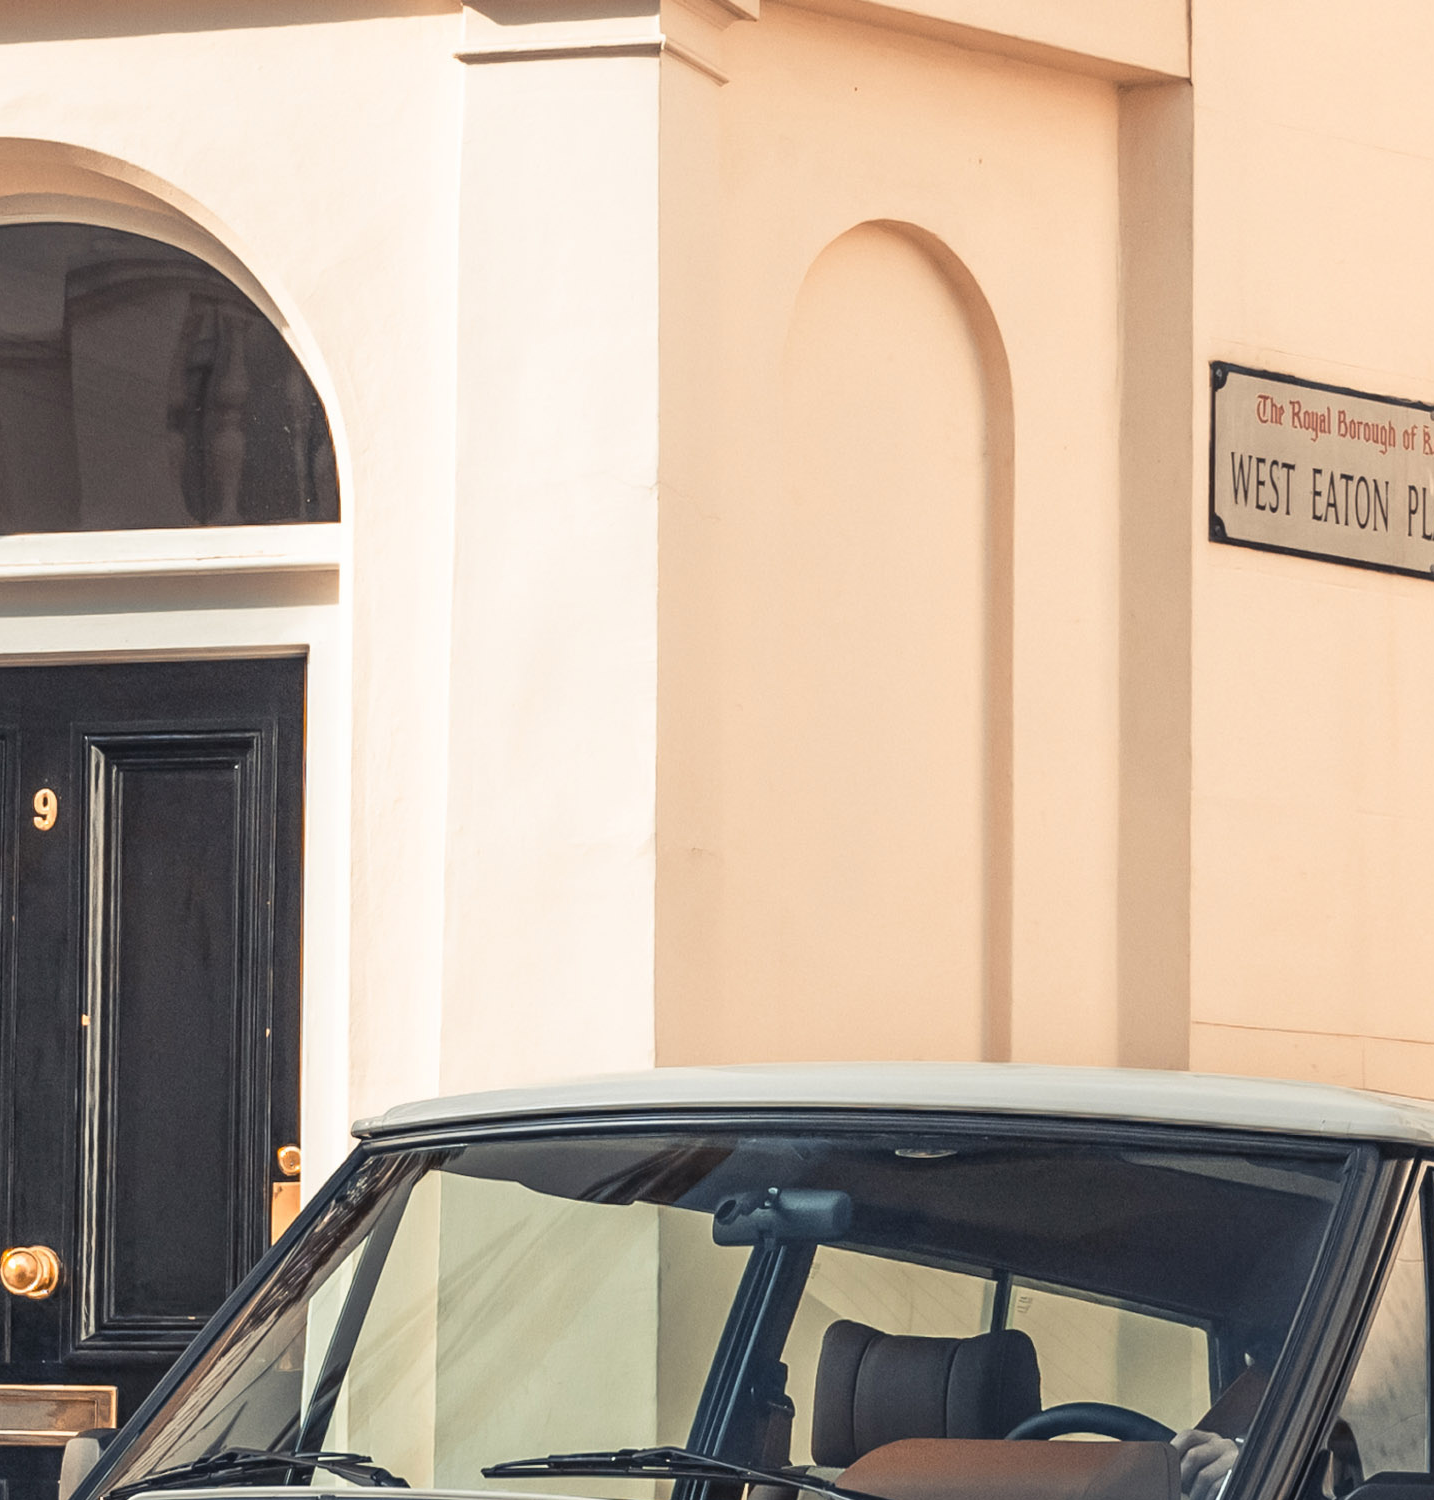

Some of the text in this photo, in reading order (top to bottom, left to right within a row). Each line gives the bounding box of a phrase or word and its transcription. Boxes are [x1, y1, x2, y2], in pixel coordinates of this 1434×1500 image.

[1257, 394, 1285, 425] The
[1290, 401, 1332, 442] Royal
[1337, 410, 1396, 454] Borough
[1402, 425, 1418, 451] of
[1230, 451, 1296, 516] WEST
[1311, 468, 1390, 532] EATON
[33, 787, 58, 831] 9
